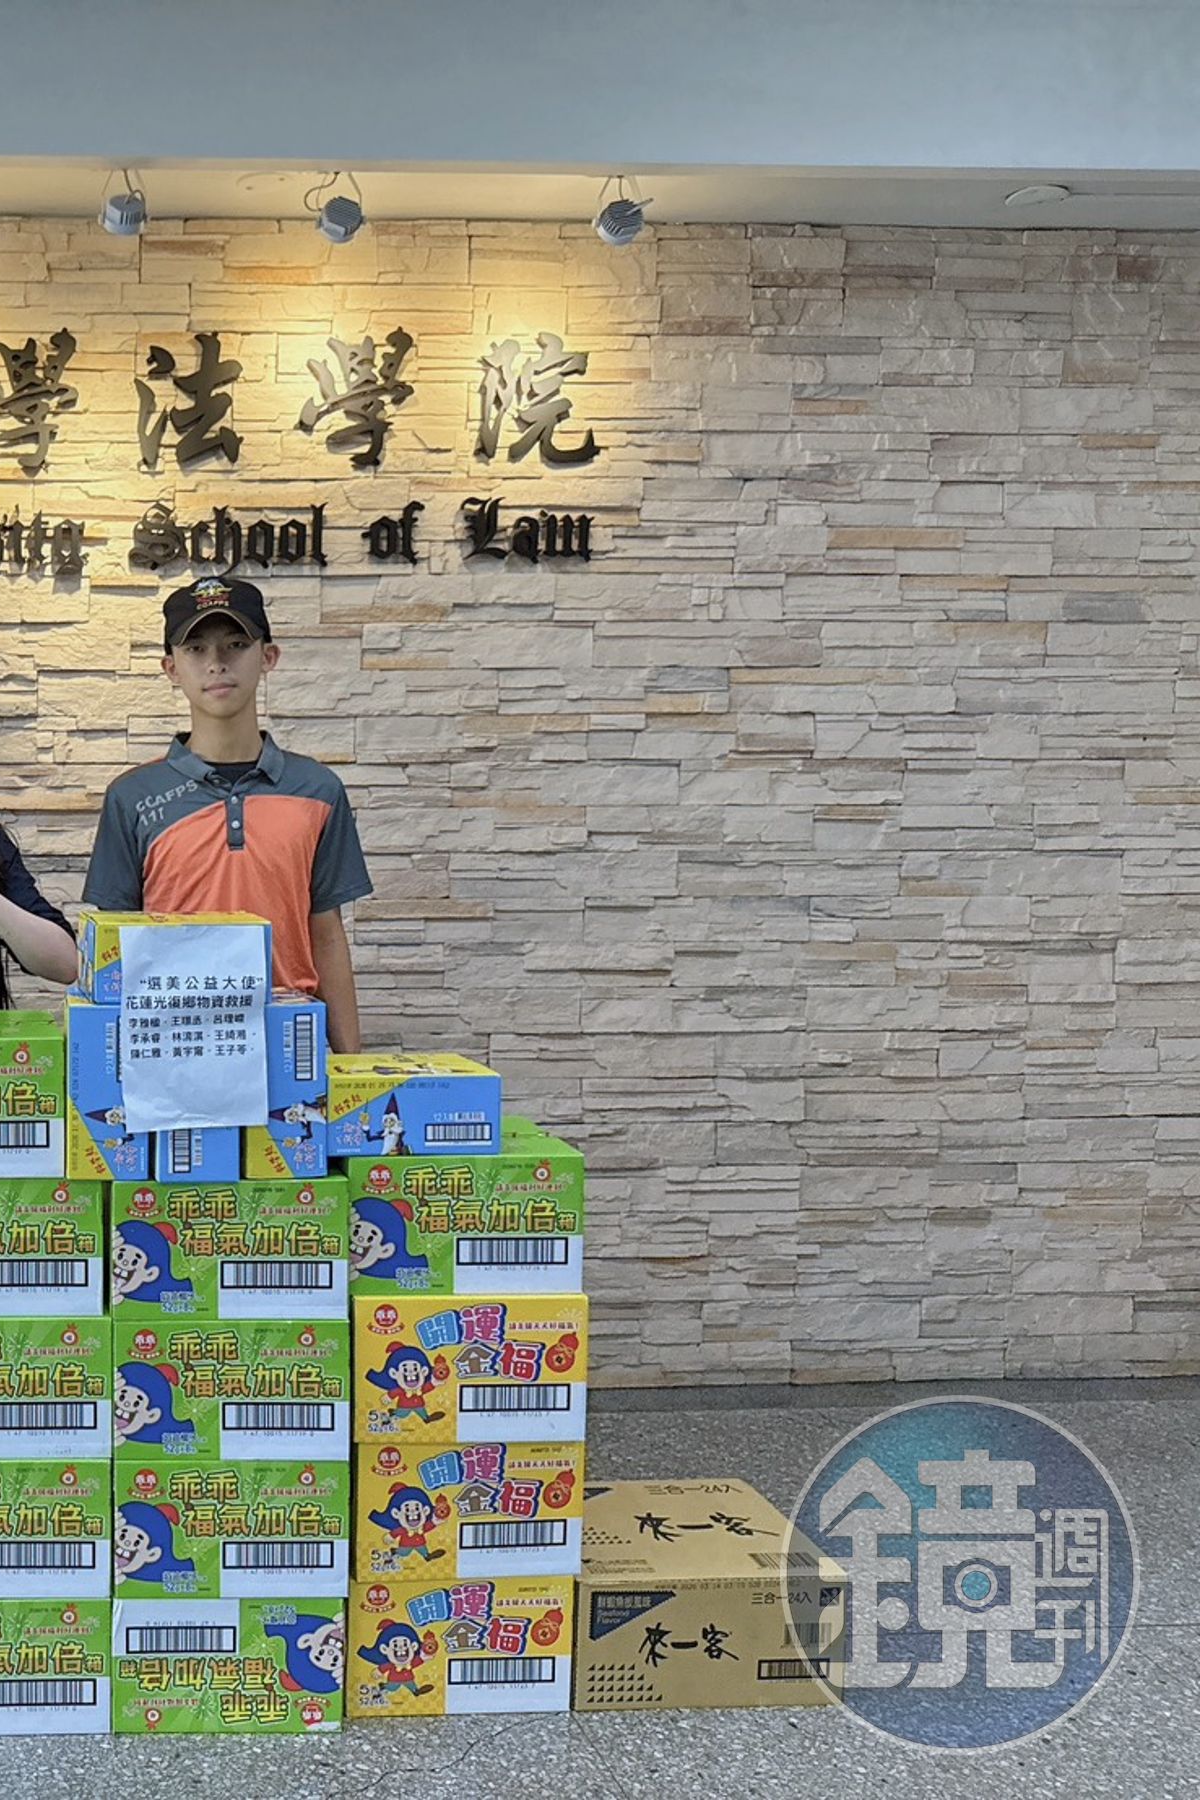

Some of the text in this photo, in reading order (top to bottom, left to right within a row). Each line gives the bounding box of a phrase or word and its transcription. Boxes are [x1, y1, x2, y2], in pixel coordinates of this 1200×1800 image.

[131, 500, 328, 574] School
[361, 500, 425, 565] of
[461, 496, 594, 564] Law
[135, 780, 199, 813] CCAFPS
[126, 994, 253, 1009] 花蓮光復鄉物資救援
[403, 1165, 474, 1199] 乖乖
[168, 1189, 238, 1221] 乖乖
[417, 1199, 577, 1234] 福氣加倍箱
[181, 1223, 341, 1256] 福氣加倍箱
[416, 1303, 509, 1350] 開運
[169, 1331, 239, 1363] 乖乖
[183, 1364, 342, 1398] 福氣加倍箱
[417, 1443, 507, 1491] 開運
[169, 1470, 239, 1503] 乖乖
[183, 1503, 342, 1537] 福氣加倍箱
[634, 1512, 780, 1542] 來一客
[406, 1581, 495, 1627] 開運
[639, 1622, 740, 1668] 來一客
[220, 1691, 290, 1724] 乖乖
